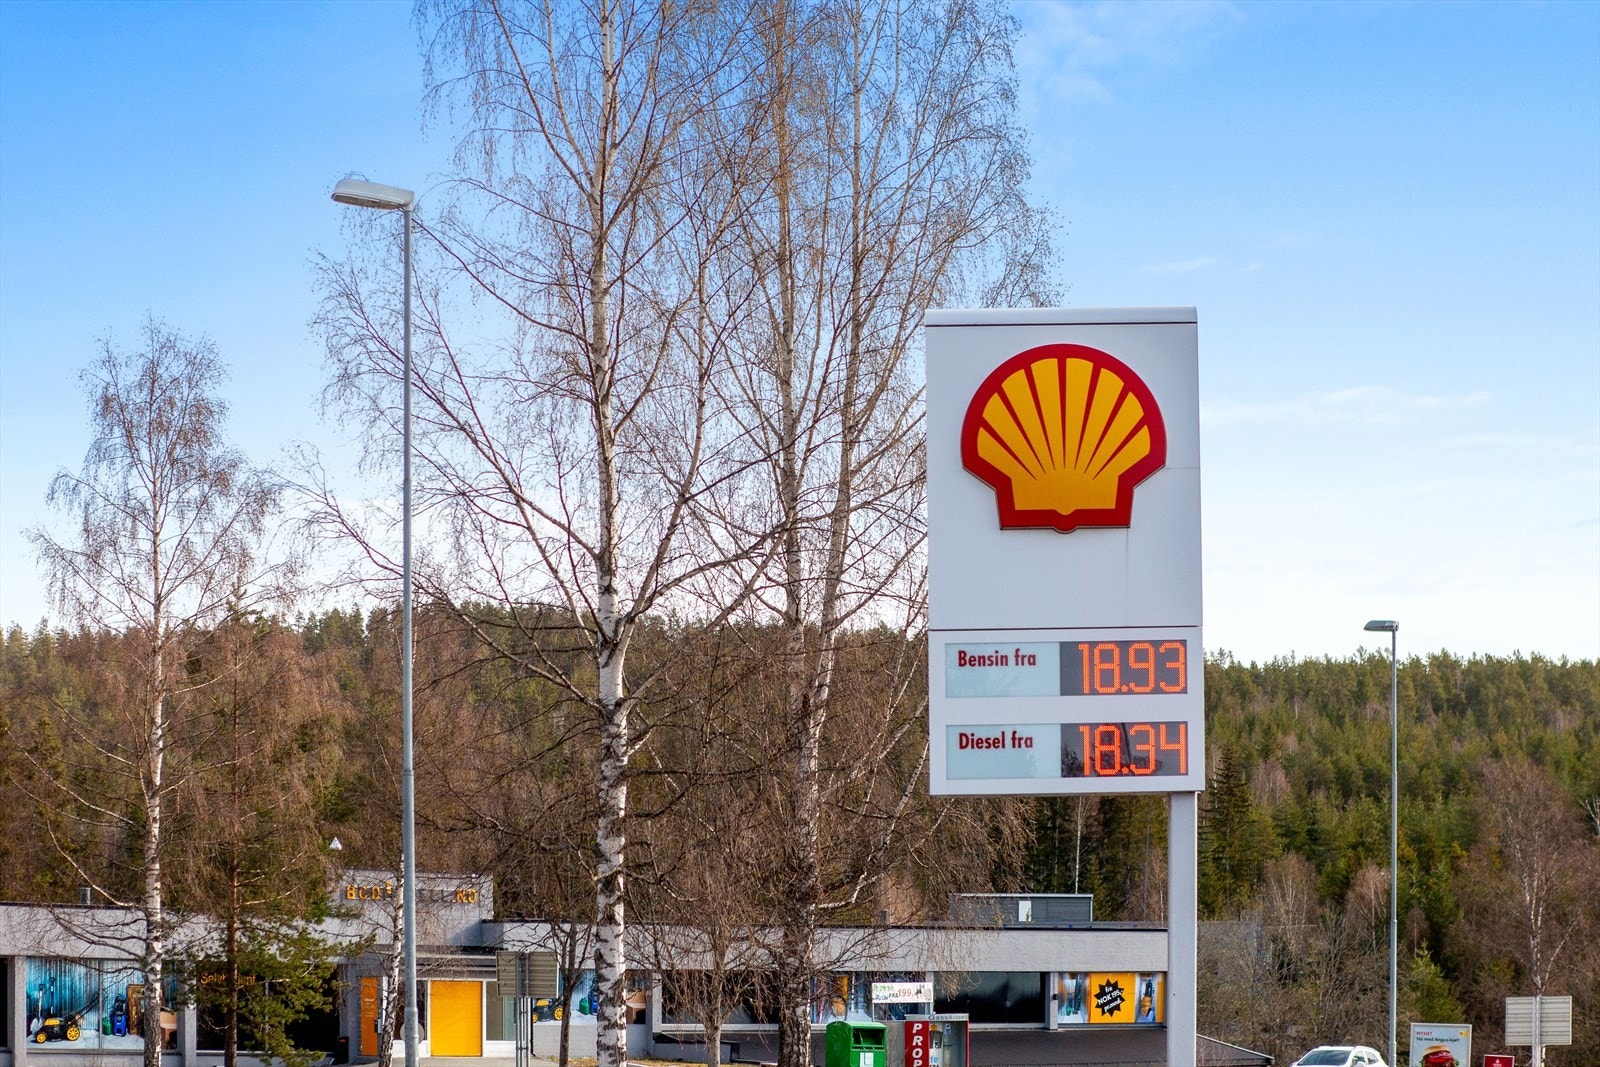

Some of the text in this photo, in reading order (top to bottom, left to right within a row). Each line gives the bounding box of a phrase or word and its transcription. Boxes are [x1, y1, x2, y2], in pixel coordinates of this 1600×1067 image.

[958, 648, 1037, 667] Bensin fra
[1078, 642, 1185, 694] 18.93
[958, 730, 1034, 750] Diesel fra
[1079, 724, 1187, 776] 18.34
[1097, 993, 1112, 1005] NOK
